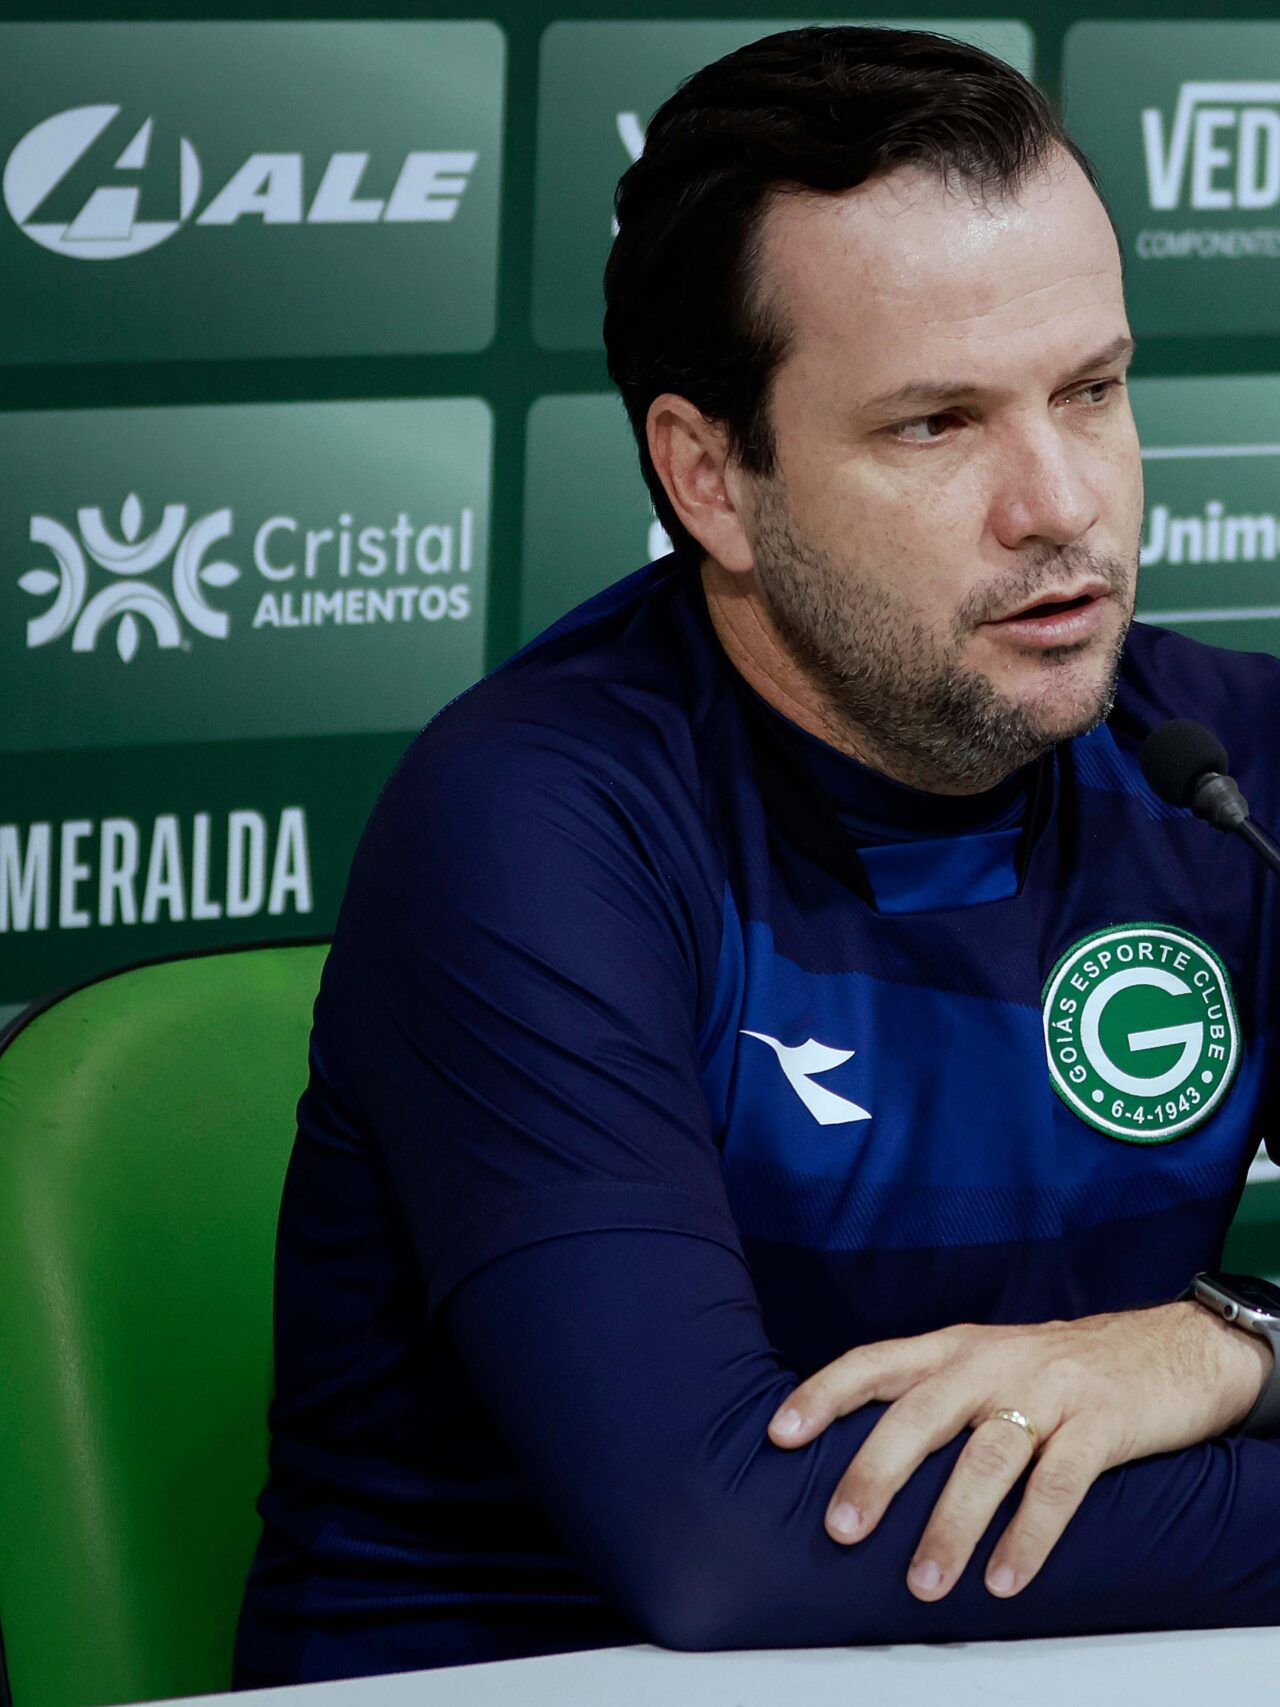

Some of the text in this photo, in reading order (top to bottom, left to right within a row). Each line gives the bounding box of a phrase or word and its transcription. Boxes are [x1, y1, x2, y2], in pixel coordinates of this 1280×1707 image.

[196, 150, 479, 225] ALE
[252, 509, 473, 581] Cristal
[252, 585, 471, 629] ALIMENTOS
[1052, 942, 1226, 1083] GOIÁS ESPORTE CLUBE
[1111, 1086, 1201, 1124] 6-4-1943
